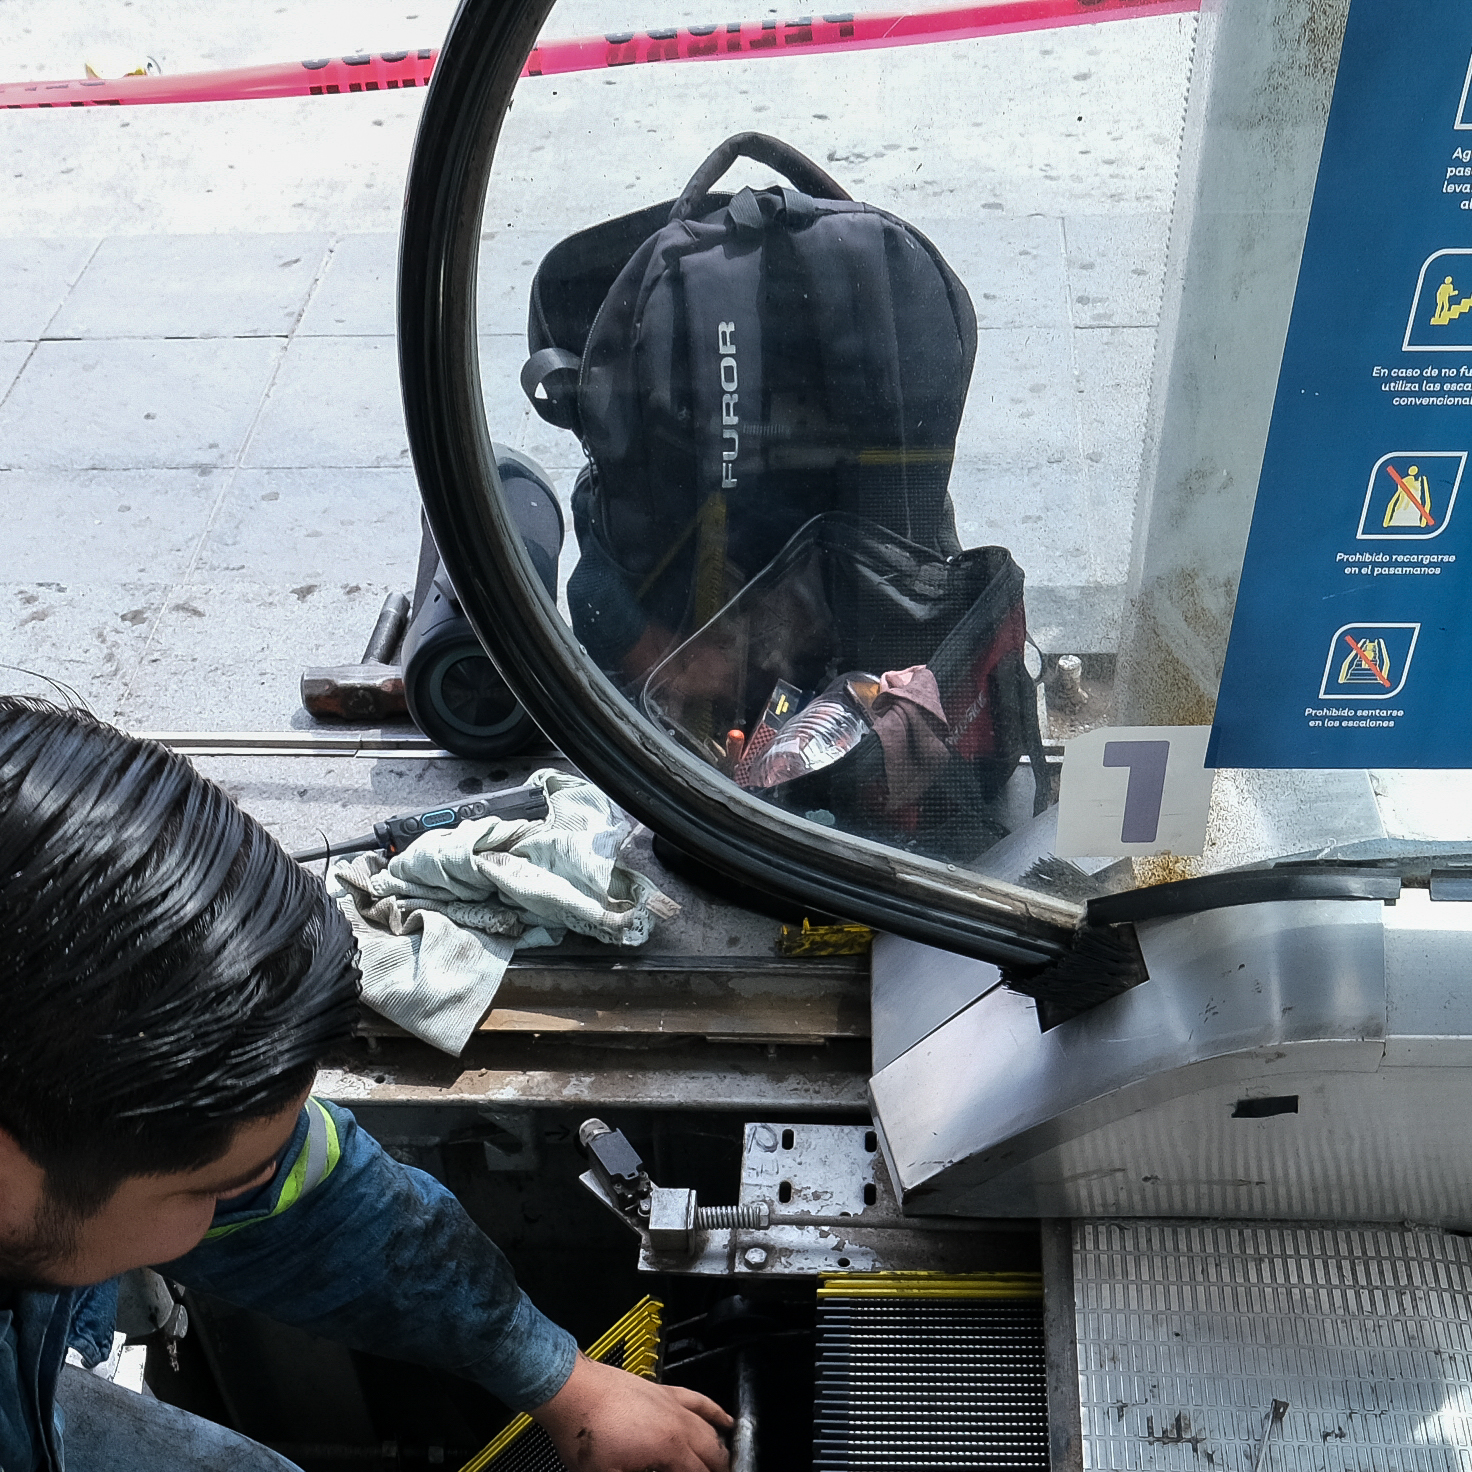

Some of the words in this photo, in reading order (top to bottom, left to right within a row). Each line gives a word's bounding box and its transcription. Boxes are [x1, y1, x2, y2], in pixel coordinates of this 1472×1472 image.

[1372, 365, 1389, 378] En
[1390, 368, 1421, 378] caso
[1422, 365, 1439, 377] de
[1441, 368, 1457, 378] no
[1381, 379, 1420, 392] utiliza
[1421, 379, 1441, 392] las
[717, 321, 740, 489] FUROR
[1335, 551, 1390, 563] Prohibido
[1391, 554, 1456, 565] recargarse
[1344, 566, 1359, 575] en
[1360, 564, 1373, 575] el
[1373, 566, 1441, 577] pasamanos
[1304, 707, 1355, 717] Prohibido
[1356, 708, 1405, 717] sentarse
[1324, 718, 1340, 728] los
[1341, 718, 1395, 728] escalones
